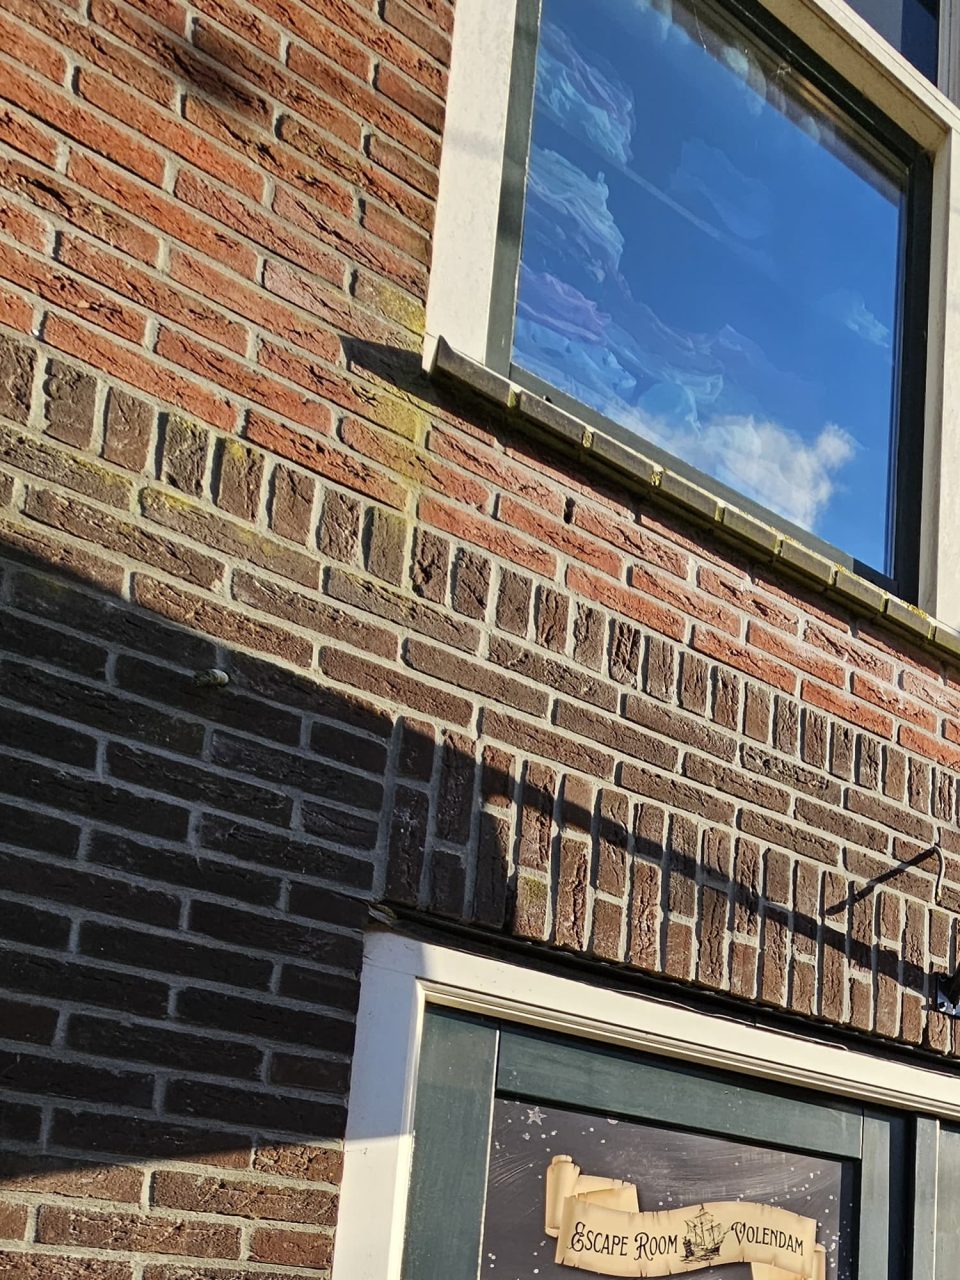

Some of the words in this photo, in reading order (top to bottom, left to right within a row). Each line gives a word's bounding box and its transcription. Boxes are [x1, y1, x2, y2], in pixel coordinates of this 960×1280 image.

[567, 1221, 629, 1256] ESCAPE
[633, 1232, 678, 1261] ROOM
[731, 1221, 803, 1256] VOLENDAM
